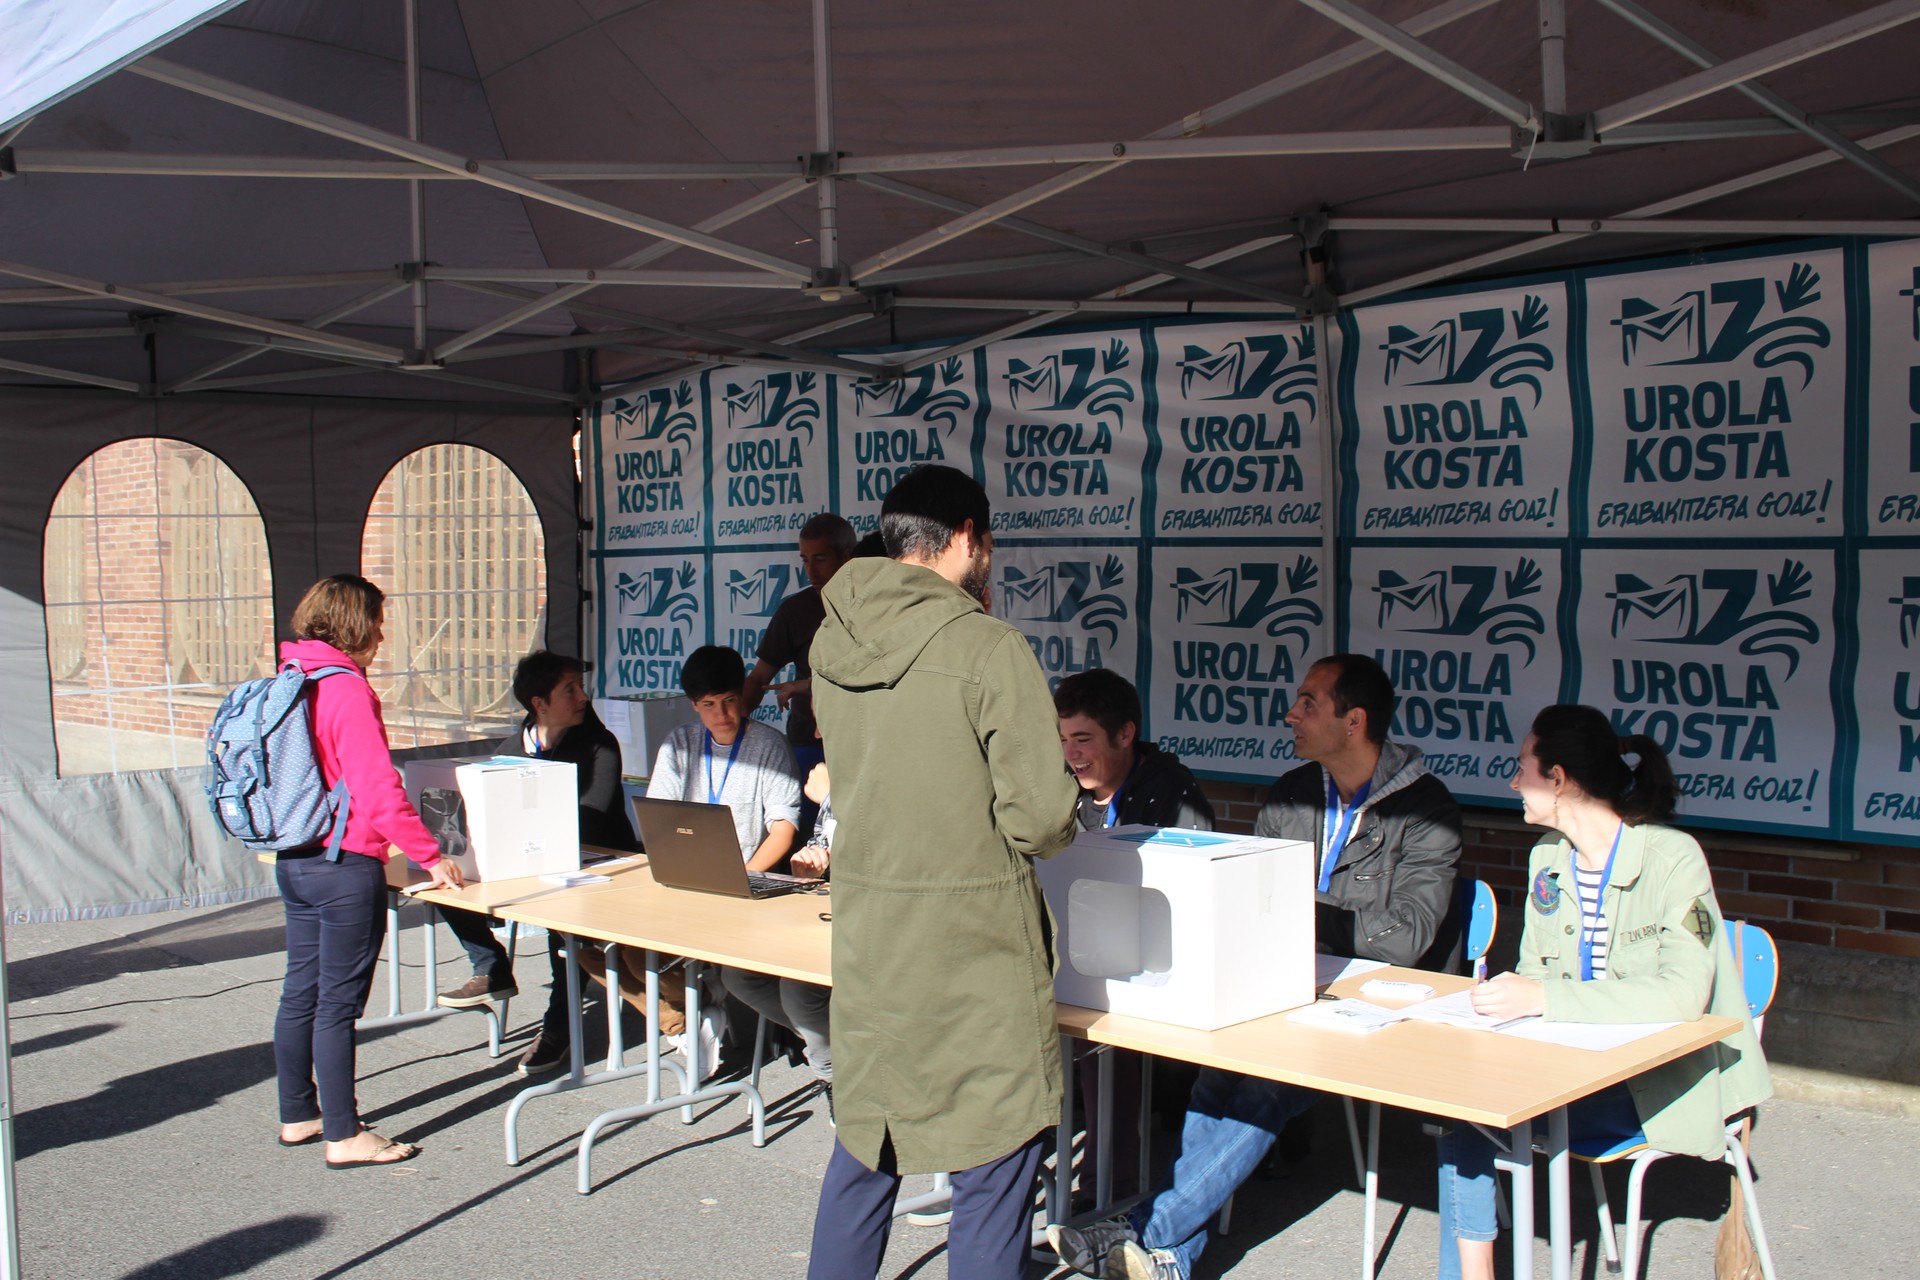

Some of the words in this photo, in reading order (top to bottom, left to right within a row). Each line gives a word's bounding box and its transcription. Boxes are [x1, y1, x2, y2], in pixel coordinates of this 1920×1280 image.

[1383, 396, 1528, 445] UROLA
[1623, 376, 1792, 433] UROLA
[855, 427, 945, 464] UROLA
[1004, 422, 1112, 458] UROLA
[1180, 411, 1301, 453] UROLA
[615, 449, 682, 481] UROLA
[726, 437, 802, 473] UROLA
[1180, 454, 1304, 494] KOSTA
[1383, 444, 1524, 490] KOSTA
[1623, 431, 1791, 483] KOSTA
[617, 481, 683, 513] KOSTA
[728, 473, 803, 507] KOSTA
[1004, 459, 1109, 497] KOSTA
[991, 510, 1084, 532] ERABAKITZERA
[1089, 497, 1135, 530] GOAZ!
[1161, 505, 1273, 531] ERABAKITZERA
[1278, 502, 1324, 530] GOAZ
[1363, 501, 1491, 529] ERABAKITZERA
[1498, 487, 1559, 528] GOAZ!
[1597, 496, 1749, 528] ERABAKITZERA
[1756, 478, 1833, 523] GOAZ!
[608, 519, 670, 541] ERABAKITZERA
[671, 511, 700, 538] GOAZ!
[718, 514, 787, 537] ERABAKITZERA
[617, 628, 684, 657] UROLA
[1025, 635, 1104, 672] ROLA
[1173, 640, 1294, 683] UROLA
[618, 660, 682, 690] KOSTA
[1375, 649, 1512, 696] UROLA
[1612, 659, 1780, 710] UROLA
[1174, 683, 1292, 728] KOSTA
[1158, 736, 1265, 760] ERABAKITZERA
[1609, 708, 1777, 763] KOSTA
[1744, 768, 1819, 812] GOAZ!
